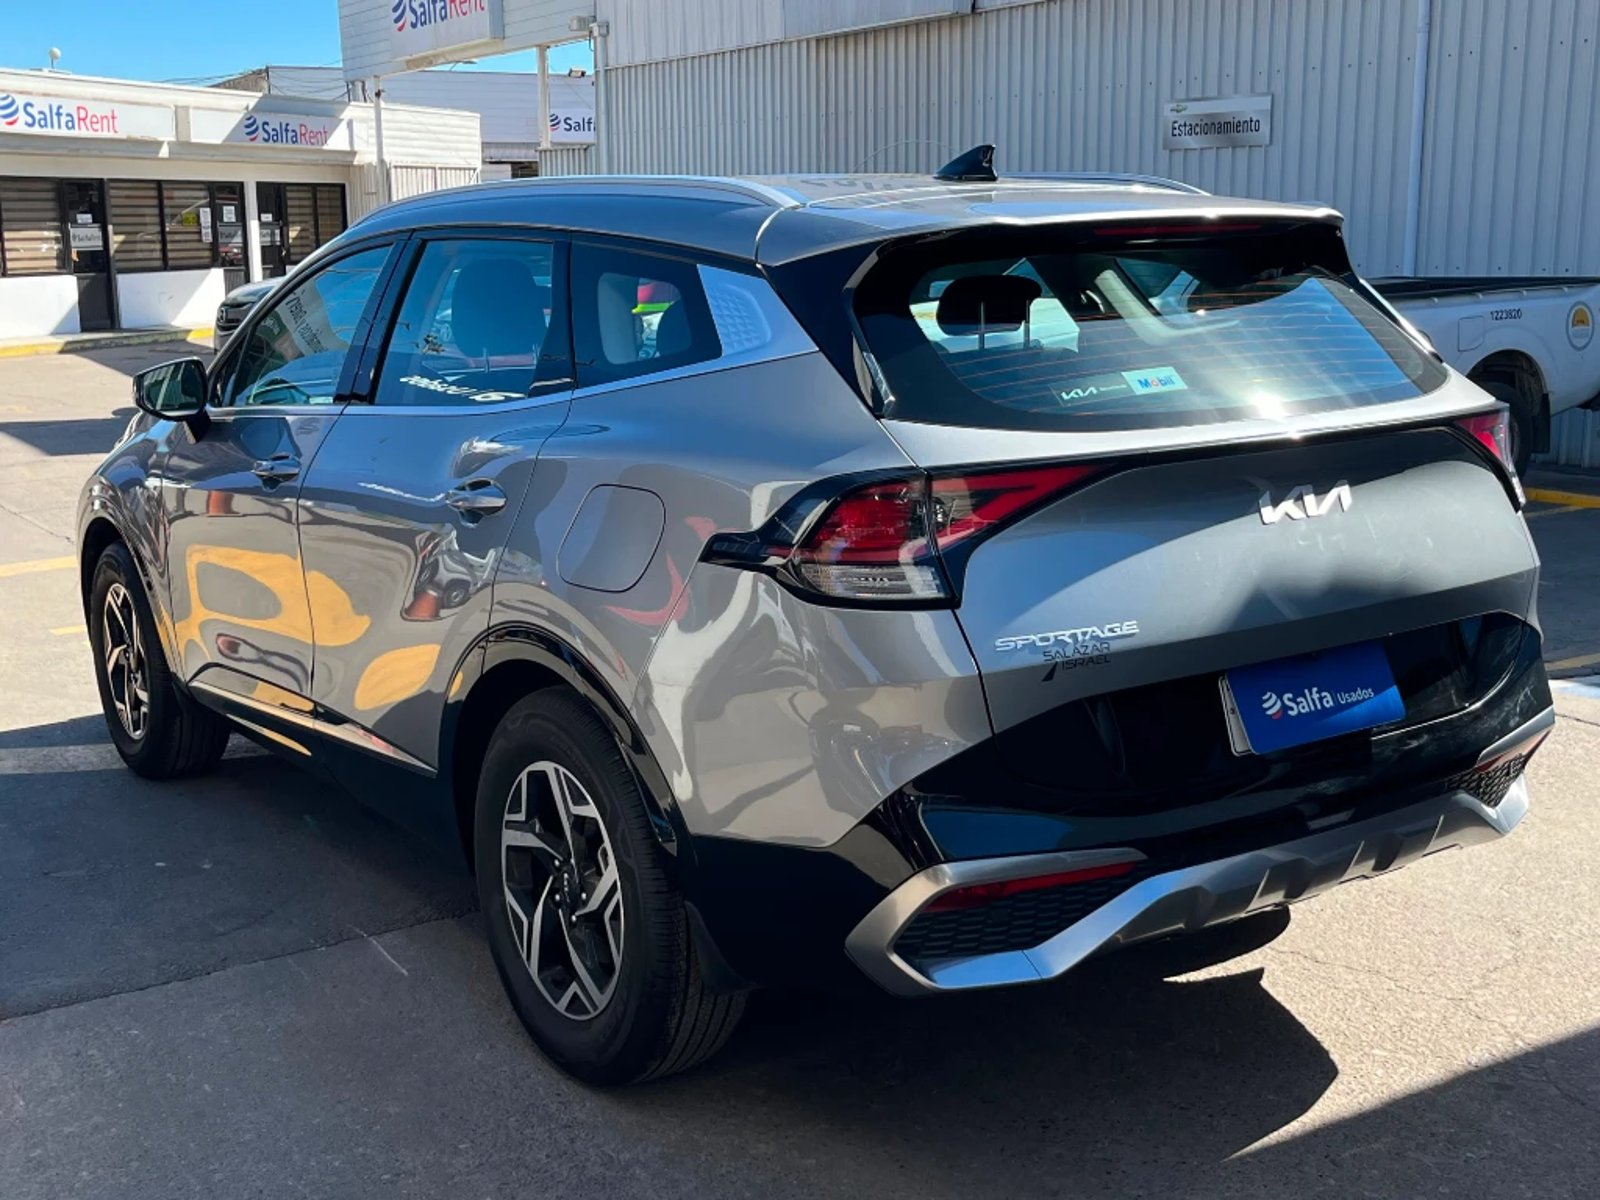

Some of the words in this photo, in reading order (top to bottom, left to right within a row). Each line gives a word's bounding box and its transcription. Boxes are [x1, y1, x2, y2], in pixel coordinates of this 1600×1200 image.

[23, 101, 119, 133] SalfaRent
[563, 116, 596, 132] Salf
[1171, 116, 1260, 137] Estacionamiento
[261, 121, 329, 146] SalfaRent
[1137, 375, 1176, 389] Mobil
[1258, 480, 1352, 525] KIA
[994, 620, 1140, 651] SPORTAGE
[1042, 641, 1111, 662] SALAZAR
[1061, 654, 1112, 670] ISRAEL
[1282, 686, 1334, 717] Salfa
[1337, 687, 1375, 705] Usados
